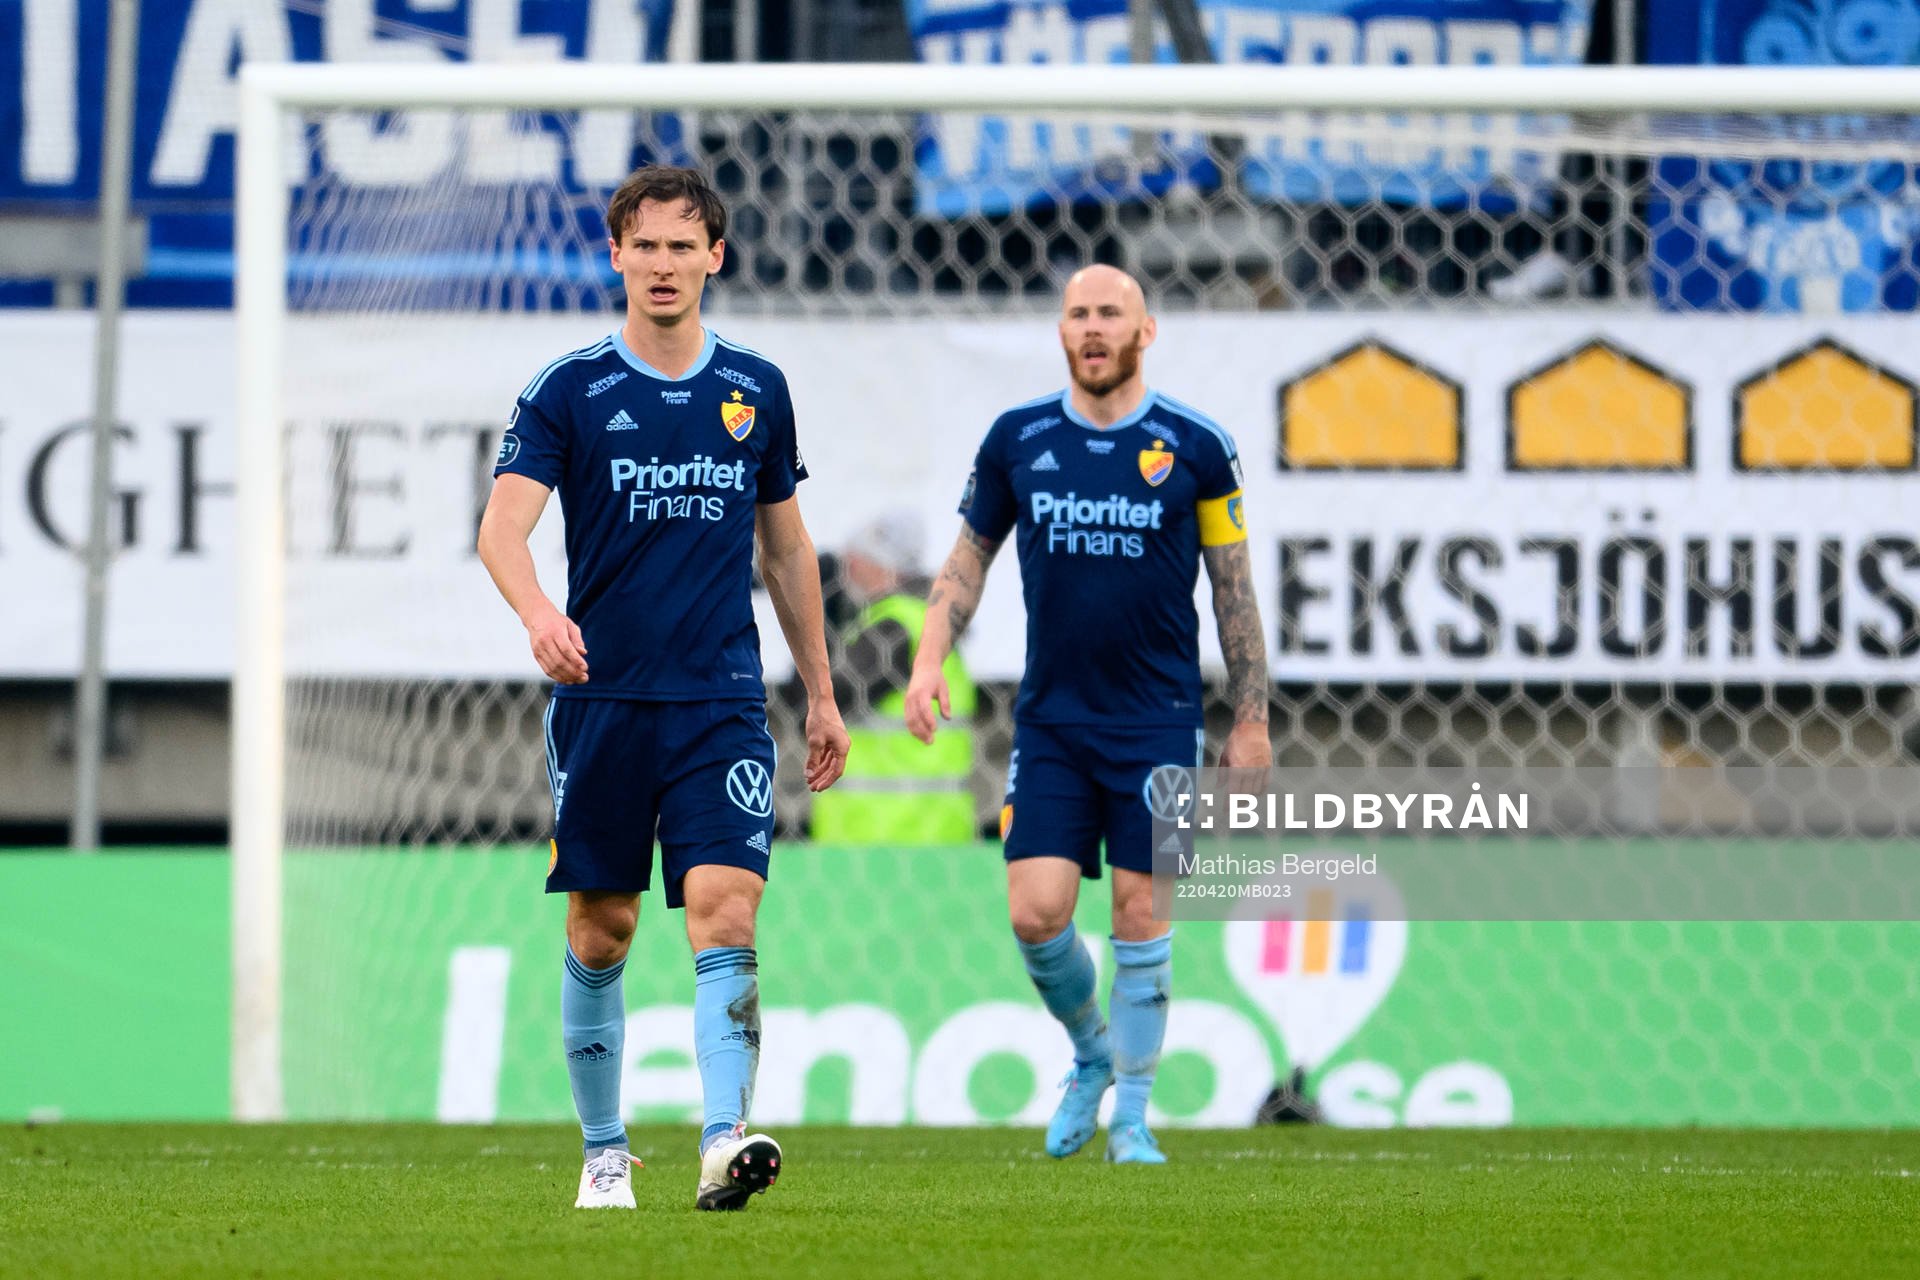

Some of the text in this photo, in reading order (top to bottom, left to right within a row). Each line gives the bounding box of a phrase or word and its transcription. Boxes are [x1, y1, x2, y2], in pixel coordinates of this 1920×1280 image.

[661, 390, 692, 399] Prioritet
[606, 422, 639, 432] adidas
[611, 454, 746, 492] Prioritet
[628, 490, 725, 523] Finans
[1031, 491, 1163, 530] Prioritet
[1048, 521, 1145, 559] Finans
[1276, 506, 1920, 662] EKSJÖHUS
[567, 1050, 615, 1062] adidas
